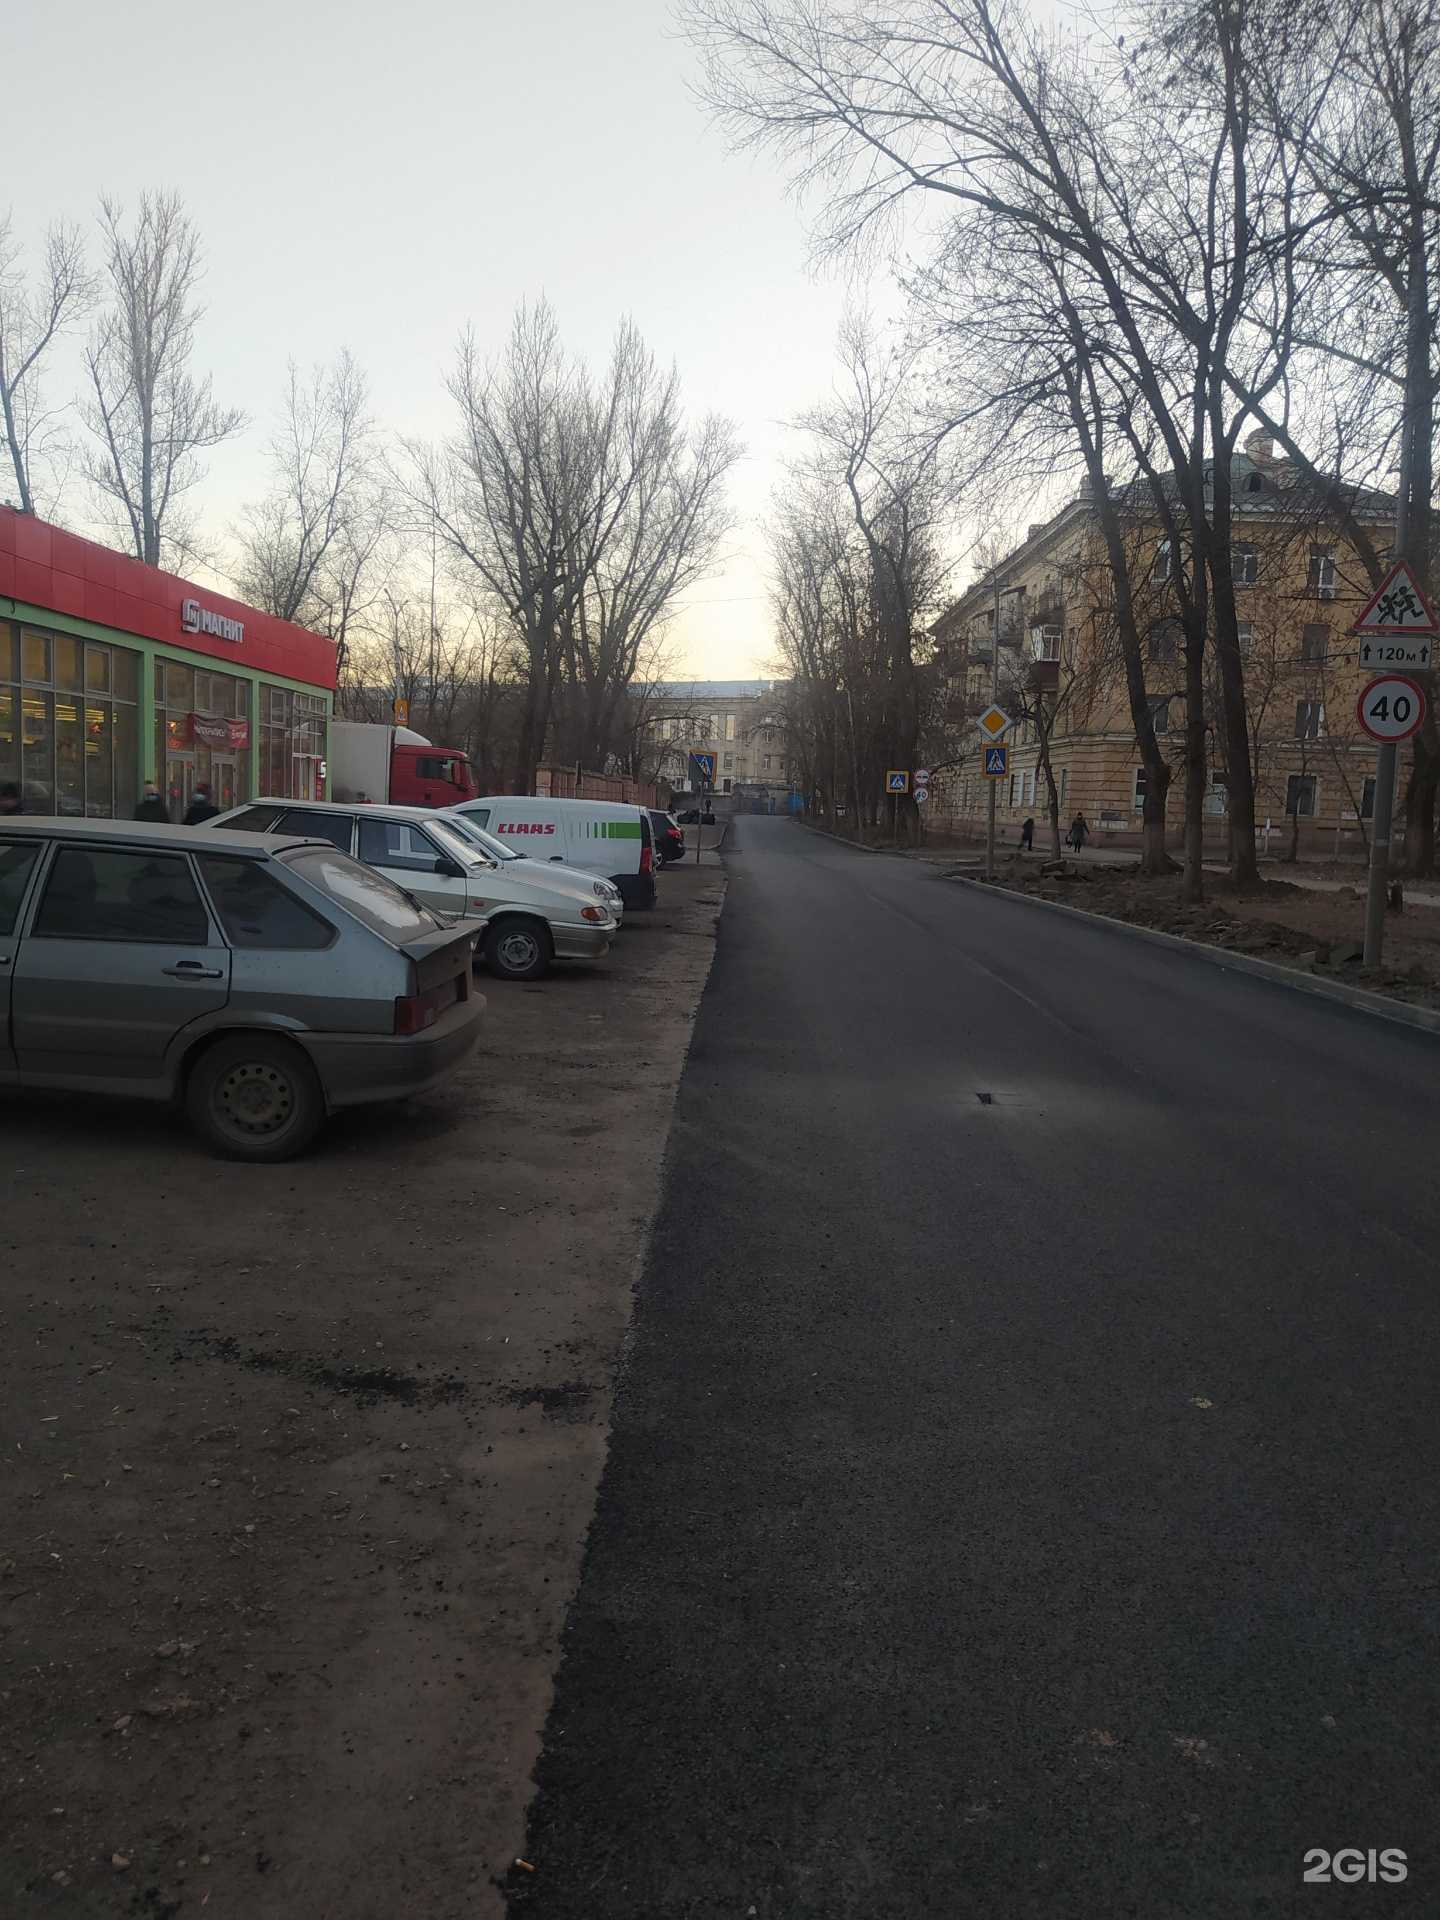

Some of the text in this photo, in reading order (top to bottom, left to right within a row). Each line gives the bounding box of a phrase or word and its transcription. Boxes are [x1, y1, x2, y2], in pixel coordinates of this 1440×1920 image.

[202, 609, 245, 642] МАГНИТ
[1369, 695, 1411, 722] 40
[497, 823, 556, 835] CLAAS
